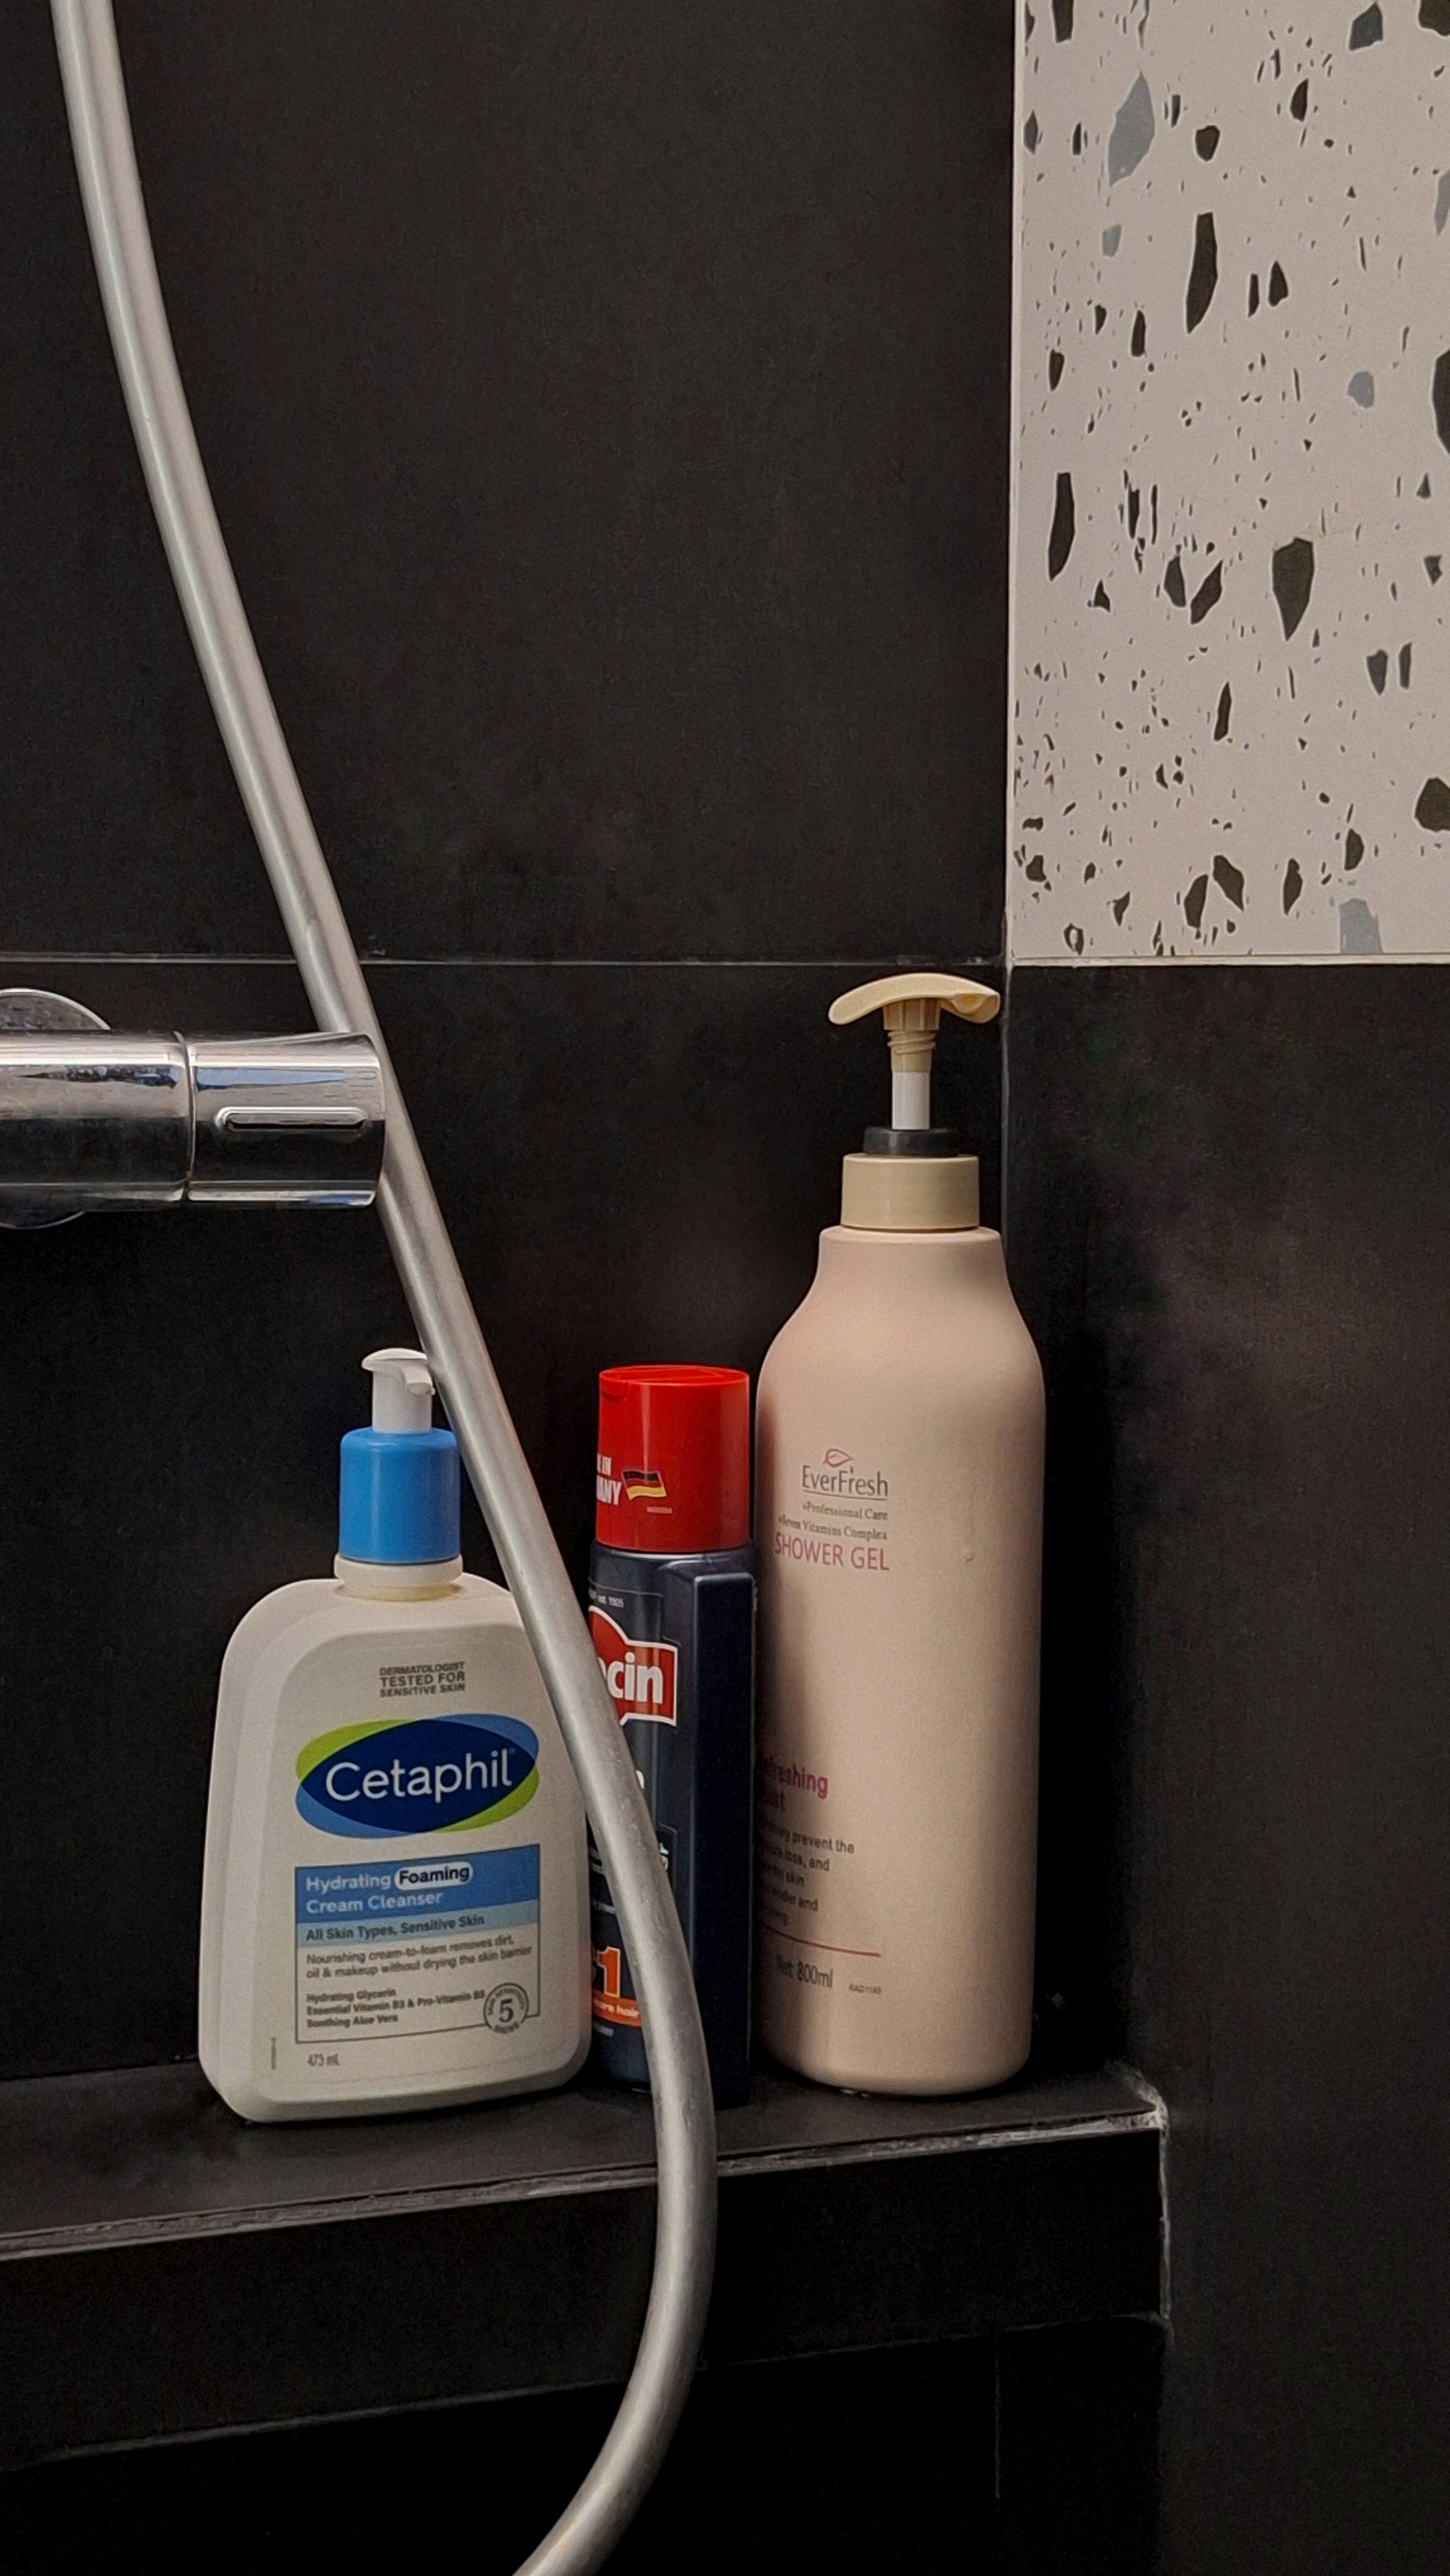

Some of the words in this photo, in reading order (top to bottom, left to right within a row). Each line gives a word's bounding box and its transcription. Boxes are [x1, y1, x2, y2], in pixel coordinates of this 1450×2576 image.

[803, 1465, 888, 1496] EverFresh
[865, 1508, 887, 1520] Care
[803, 1520, 841, 1535] Vitamins
[844, 1526, 887, 1542] Complex
[775, 1531, 844, 1566] SHOWER
[851, 1547, 890, 1570] GEL
[380, 1661, 465, 1676] DERMATOLOGIST
[380, 1674, 434, 1688] TESTED
[438, 1671, 465, 1684] FOR
[380, 1685, 437, 1697] SENSITIVE
[440, 1683, 465, 1693] SKIN
[325, 1748, 513, 1803] Cetaphil
[792, 1831, 832, 1852] prevent
[836, 1839, 855, 1854] the
[809, 1859, 830, 1871] and
[306, 1873, 391, 1895] Hydrating
[399, 1864, 470, 1886] Foaming
[306, 1897, 364, 1914] Cream
[368, 1892, 443, 1911] Cleanser
[798, 1897, 819, 1911] and
[306, 1929, 323, 1942] All
[326, 1926, 355, 1940] Skin
[357, 1924, 398, 1940] Types,
[400, 1917, 456, 1935] Sensitive
[458, 1914, 486, 1929] Skin
[306, 1952, 366, 1964] Nourishing
[369, 1944, 447, 1960] cream-to-foam
[450, 1939, 493, 1952] removes
[306, 1967, 320, 1978] oil
[322, 1967, 331, 1977] &
[335, 1965, 379, 1977] makeup
[381, 1959, 421, 1972] without
[423, 1958, 457, 1971] drying
[459, 1954, 476, 1965] the
[478, 1951, 498, 1963] skin
[501, 1945, 533, 1960] barrier
[797, 1960, 833, 1988] 800ml
[306, 1992, 354, 2005] Hydrating
[357, 1988, 397, 2001] Glycerin
[353, 2001, 390, 2013] Vitamin
[353, 2015, 375, 2025] Aloe
[377, 2014, 398, 2024] Vera
[498, 1998, 513, 2023] 5
